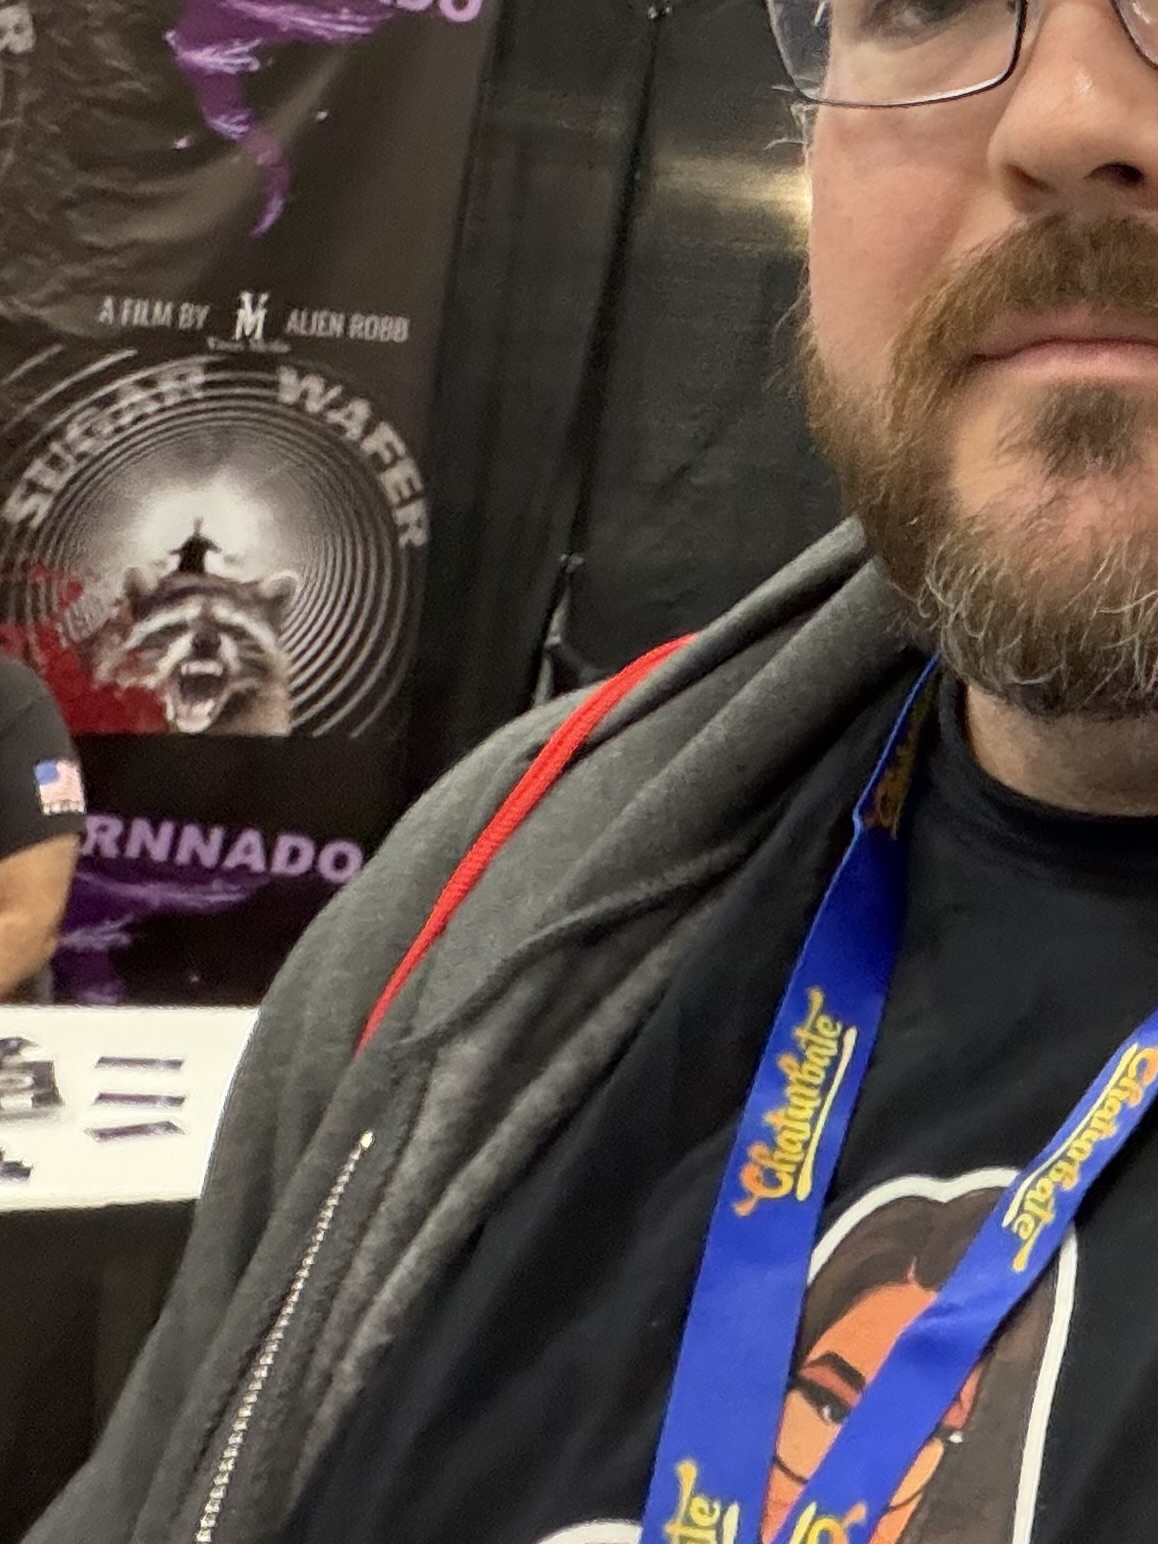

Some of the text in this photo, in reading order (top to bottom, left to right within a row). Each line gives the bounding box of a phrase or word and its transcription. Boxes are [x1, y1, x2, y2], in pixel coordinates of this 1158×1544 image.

[99, 296, 115, 326] A
[120, 298, 174, 328] FILM
[178, 302, 210, 330] BY
[2, 361, 430, 548] SUGAR WAFER
[80, 814, 364, 884] RNNADO
[734, 986, 846, 1217] Chaturbate
